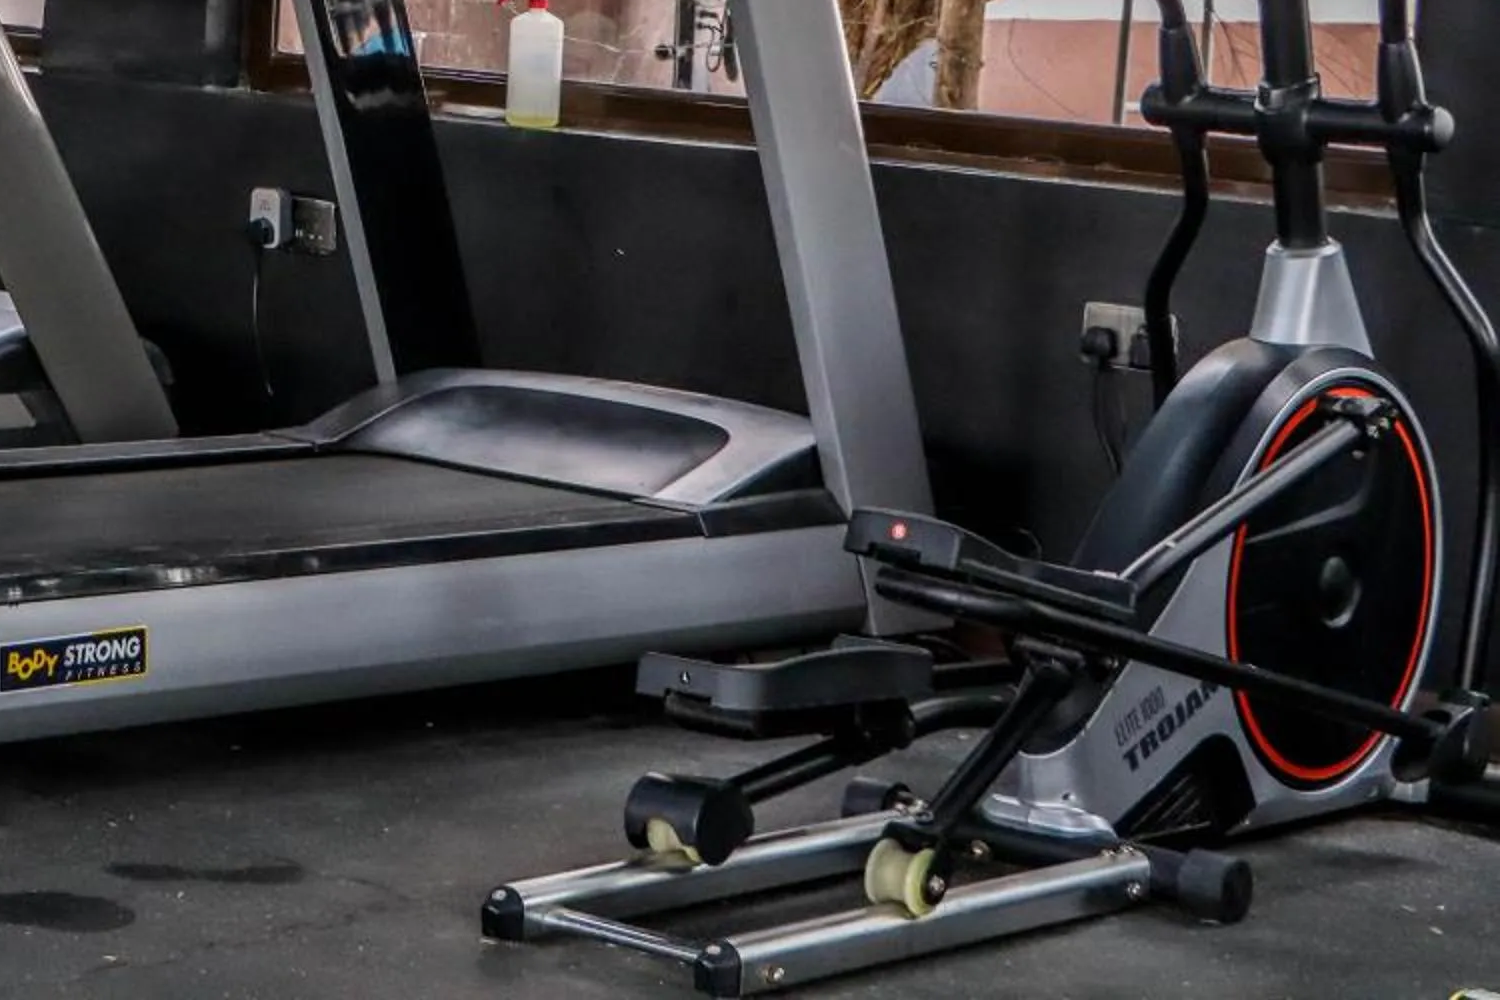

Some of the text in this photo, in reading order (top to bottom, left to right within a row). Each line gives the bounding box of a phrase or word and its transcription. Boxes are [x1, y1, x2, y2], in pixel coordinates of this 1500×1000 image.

[7, 636, 141, 680] BODY STRONG
[65, 661, 141, 681] FITNESS
